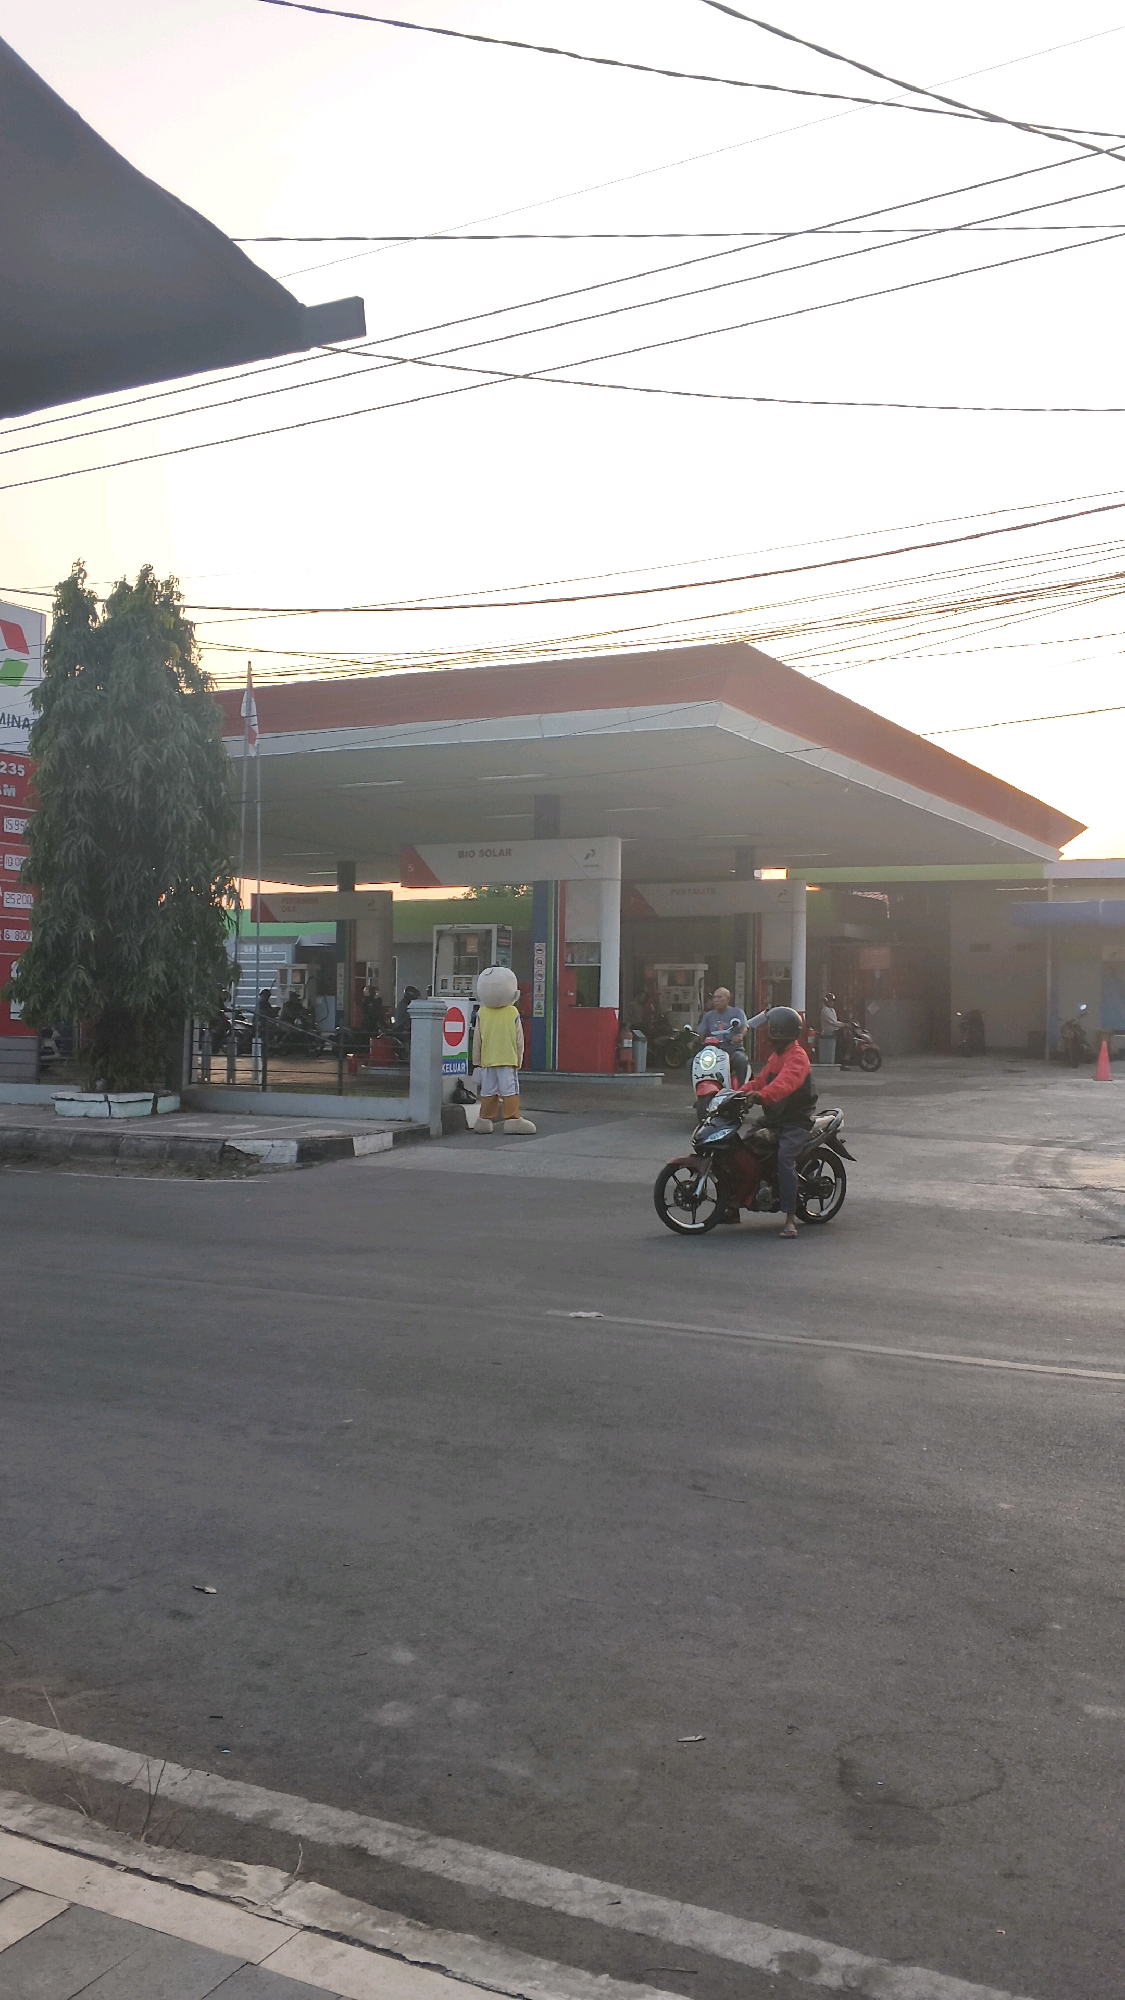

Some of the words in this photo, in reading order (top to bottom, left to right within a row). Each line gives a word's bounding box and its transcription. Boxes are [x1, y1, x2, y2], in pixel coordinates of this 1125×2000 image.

[457, 850, 475, 859] BIO
[478, 848, 512, 857] SOLAR
[670, 887, 717, 896] PERTALITE
